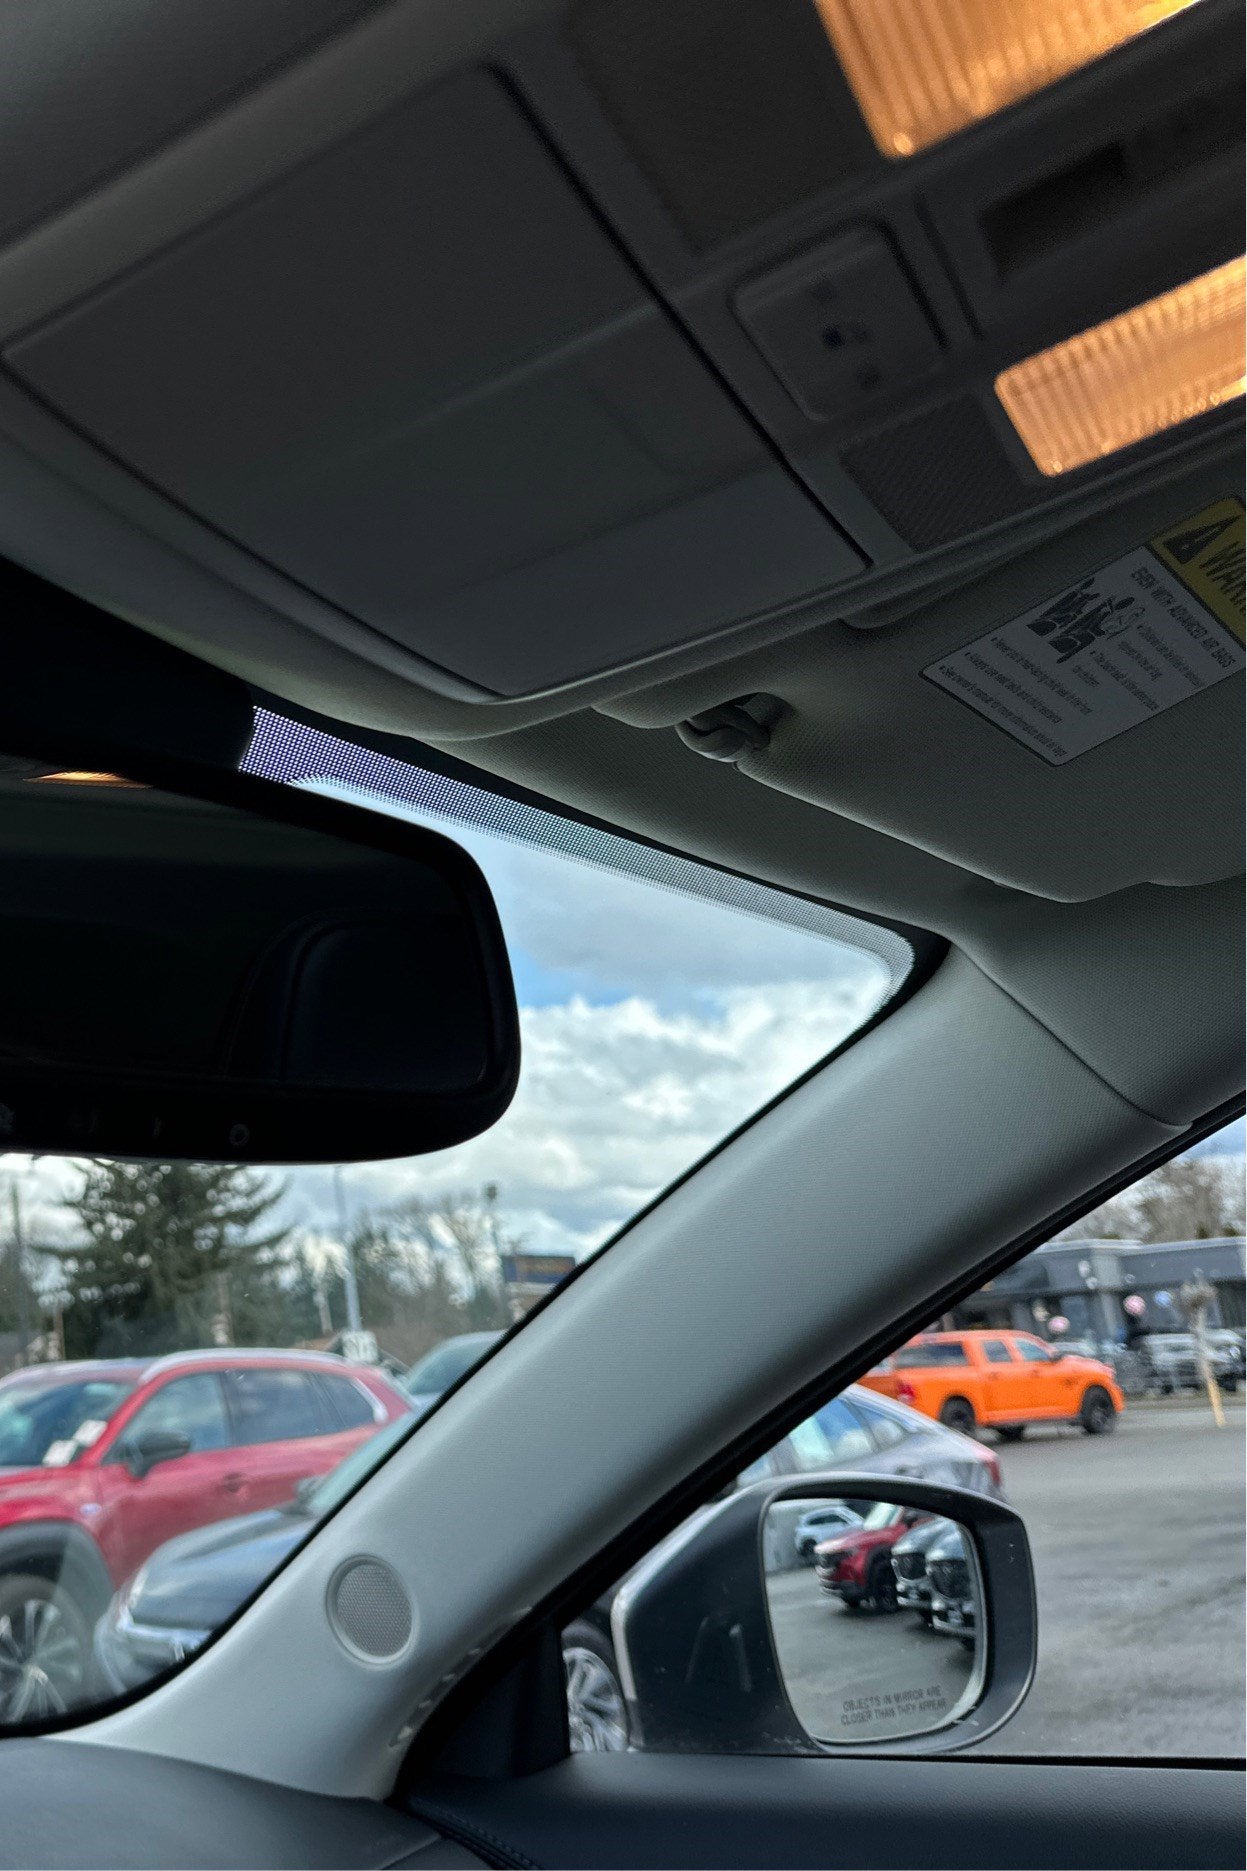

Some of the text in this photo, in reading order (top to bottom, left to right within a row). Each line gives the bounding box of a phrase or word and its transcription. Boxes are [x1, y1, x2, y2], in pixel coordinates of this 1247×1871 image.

[1199, 541, 1245, 616] WAR
[1149, 585, 1176, 608] WITH
[1166, 602, 1208, 641] ADVANCED
[1198, 635, 1220, 652] AIR
[1209, 646, 1236, 668] BAGS
[840, 1698, 947, 1725] CLOSER THAN THEY APPEAR
[842, 1685, 941, 1712] OBJECTS IN MIRROR ARE
